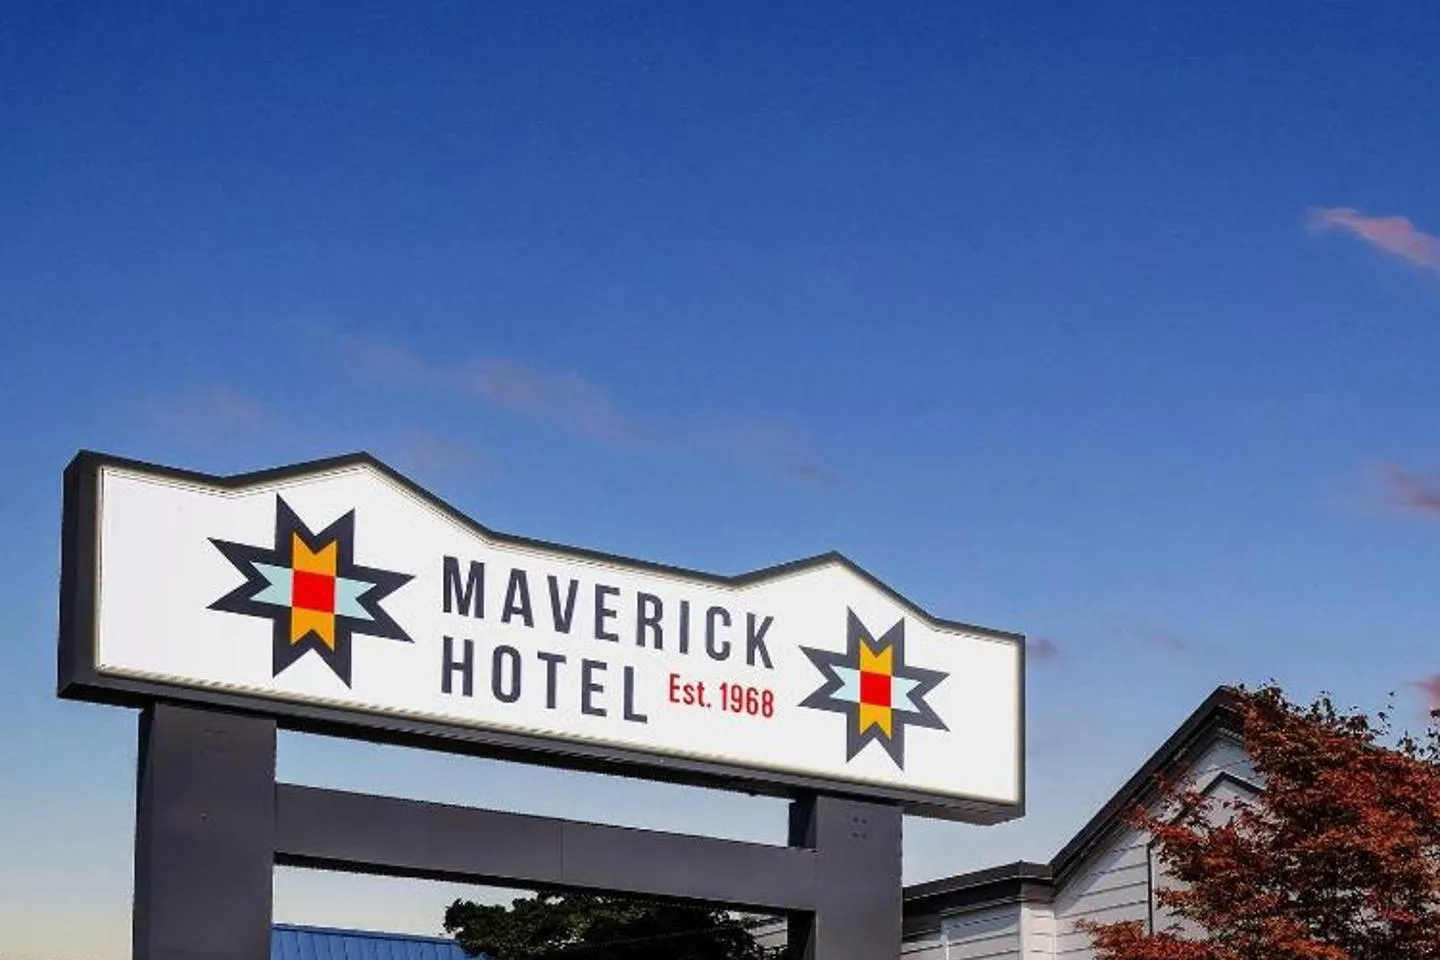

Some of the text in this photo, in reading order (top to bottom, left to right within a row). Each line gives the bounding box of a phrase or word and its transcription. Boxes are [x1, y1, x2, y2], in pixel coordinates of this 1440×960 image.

[442, 555, 774, 669] MAVERICK
[441, 636, 648, 724] HOTEL
[668, 673, 774, 718] Est. 1968
